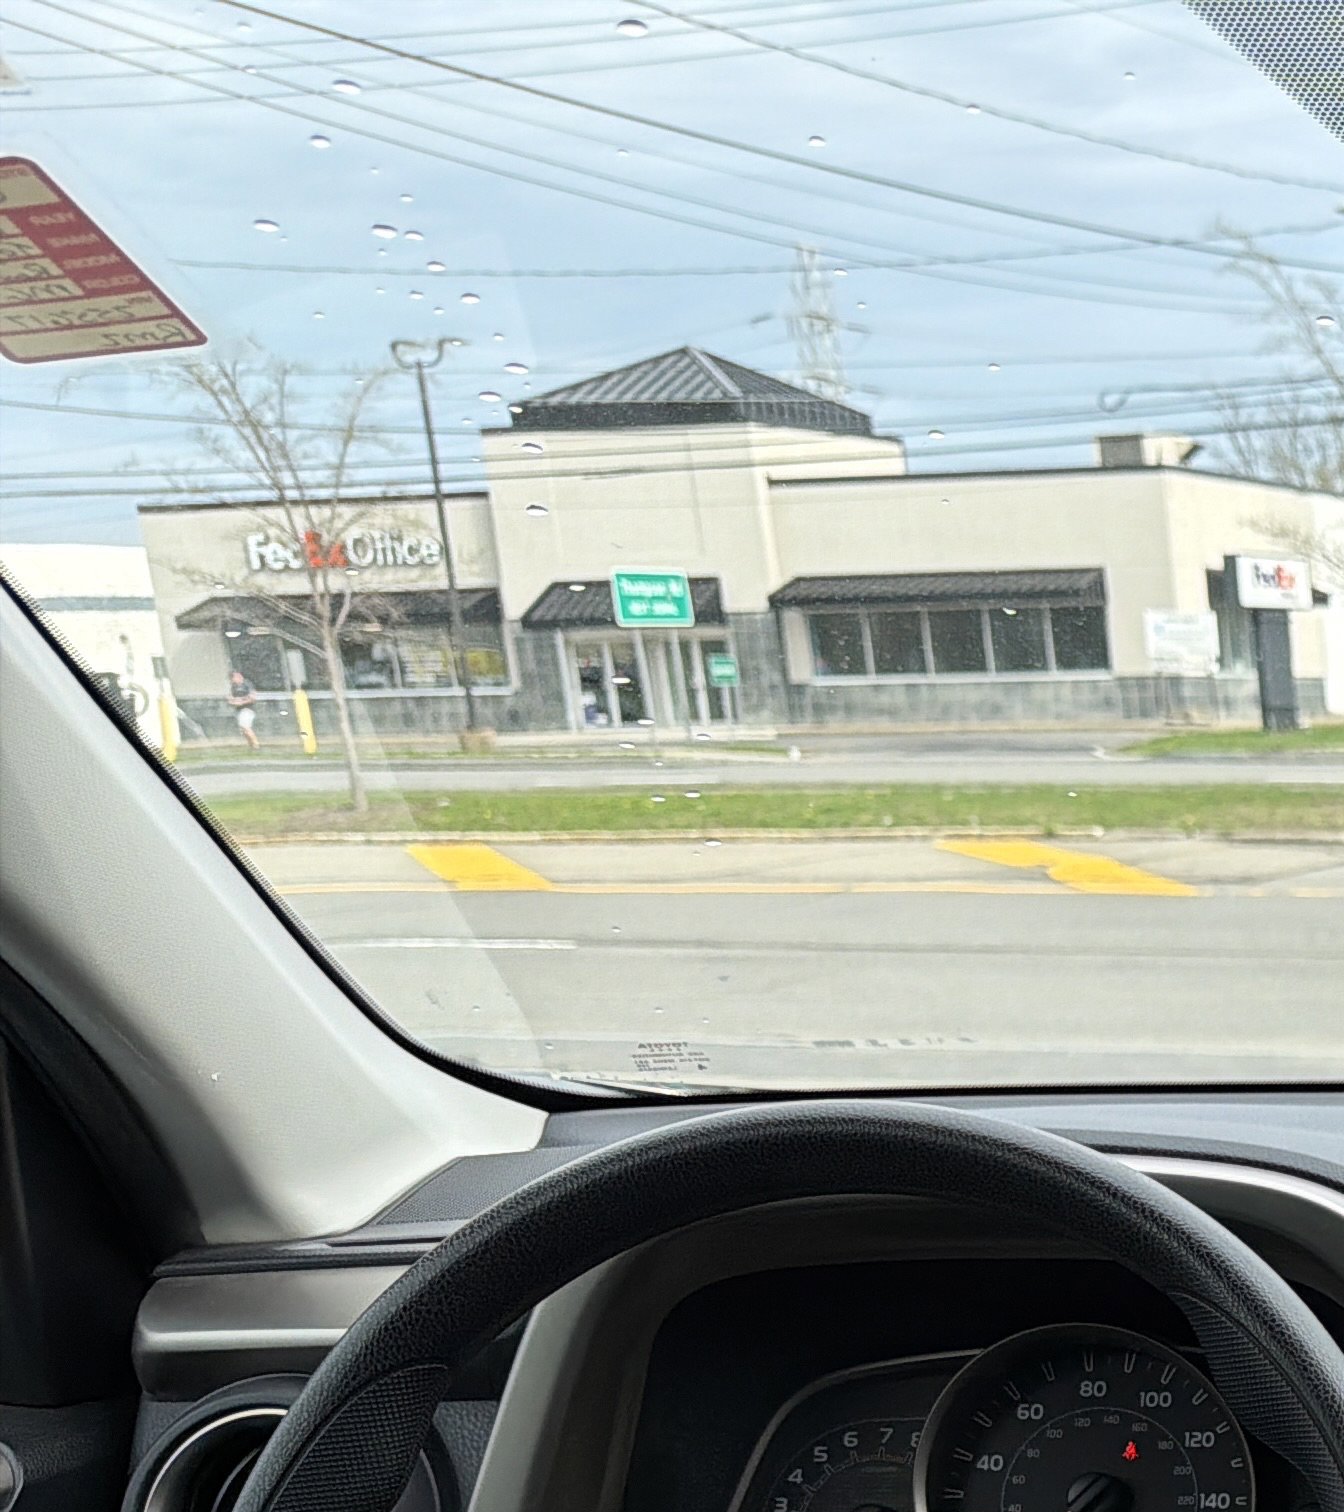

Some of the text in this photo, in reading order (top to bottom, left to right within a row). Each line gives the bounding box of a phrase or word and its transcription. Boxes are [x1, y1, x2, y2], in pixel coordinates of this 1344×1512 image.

[346, 529, 442, 567] Office
[1079, 1380, 1107, 1398] 80
[1139, 1391, 1172, 1408] 100
[1016, 1403, 1044, 1421] 60
[843, 1431, 859, 1448] 6
[879, 1427, 894, 1444] 7
[1184, 1431, 1215, 1449] 120
[813, 1446, 829, 1463] 5
[976, 1454, 1004, 1472] 40
[787, 1468, 803, 1484] 4
[1012, 1475, 1026, 1486] 60
[1199, 1492, 1231, 1510] 140
